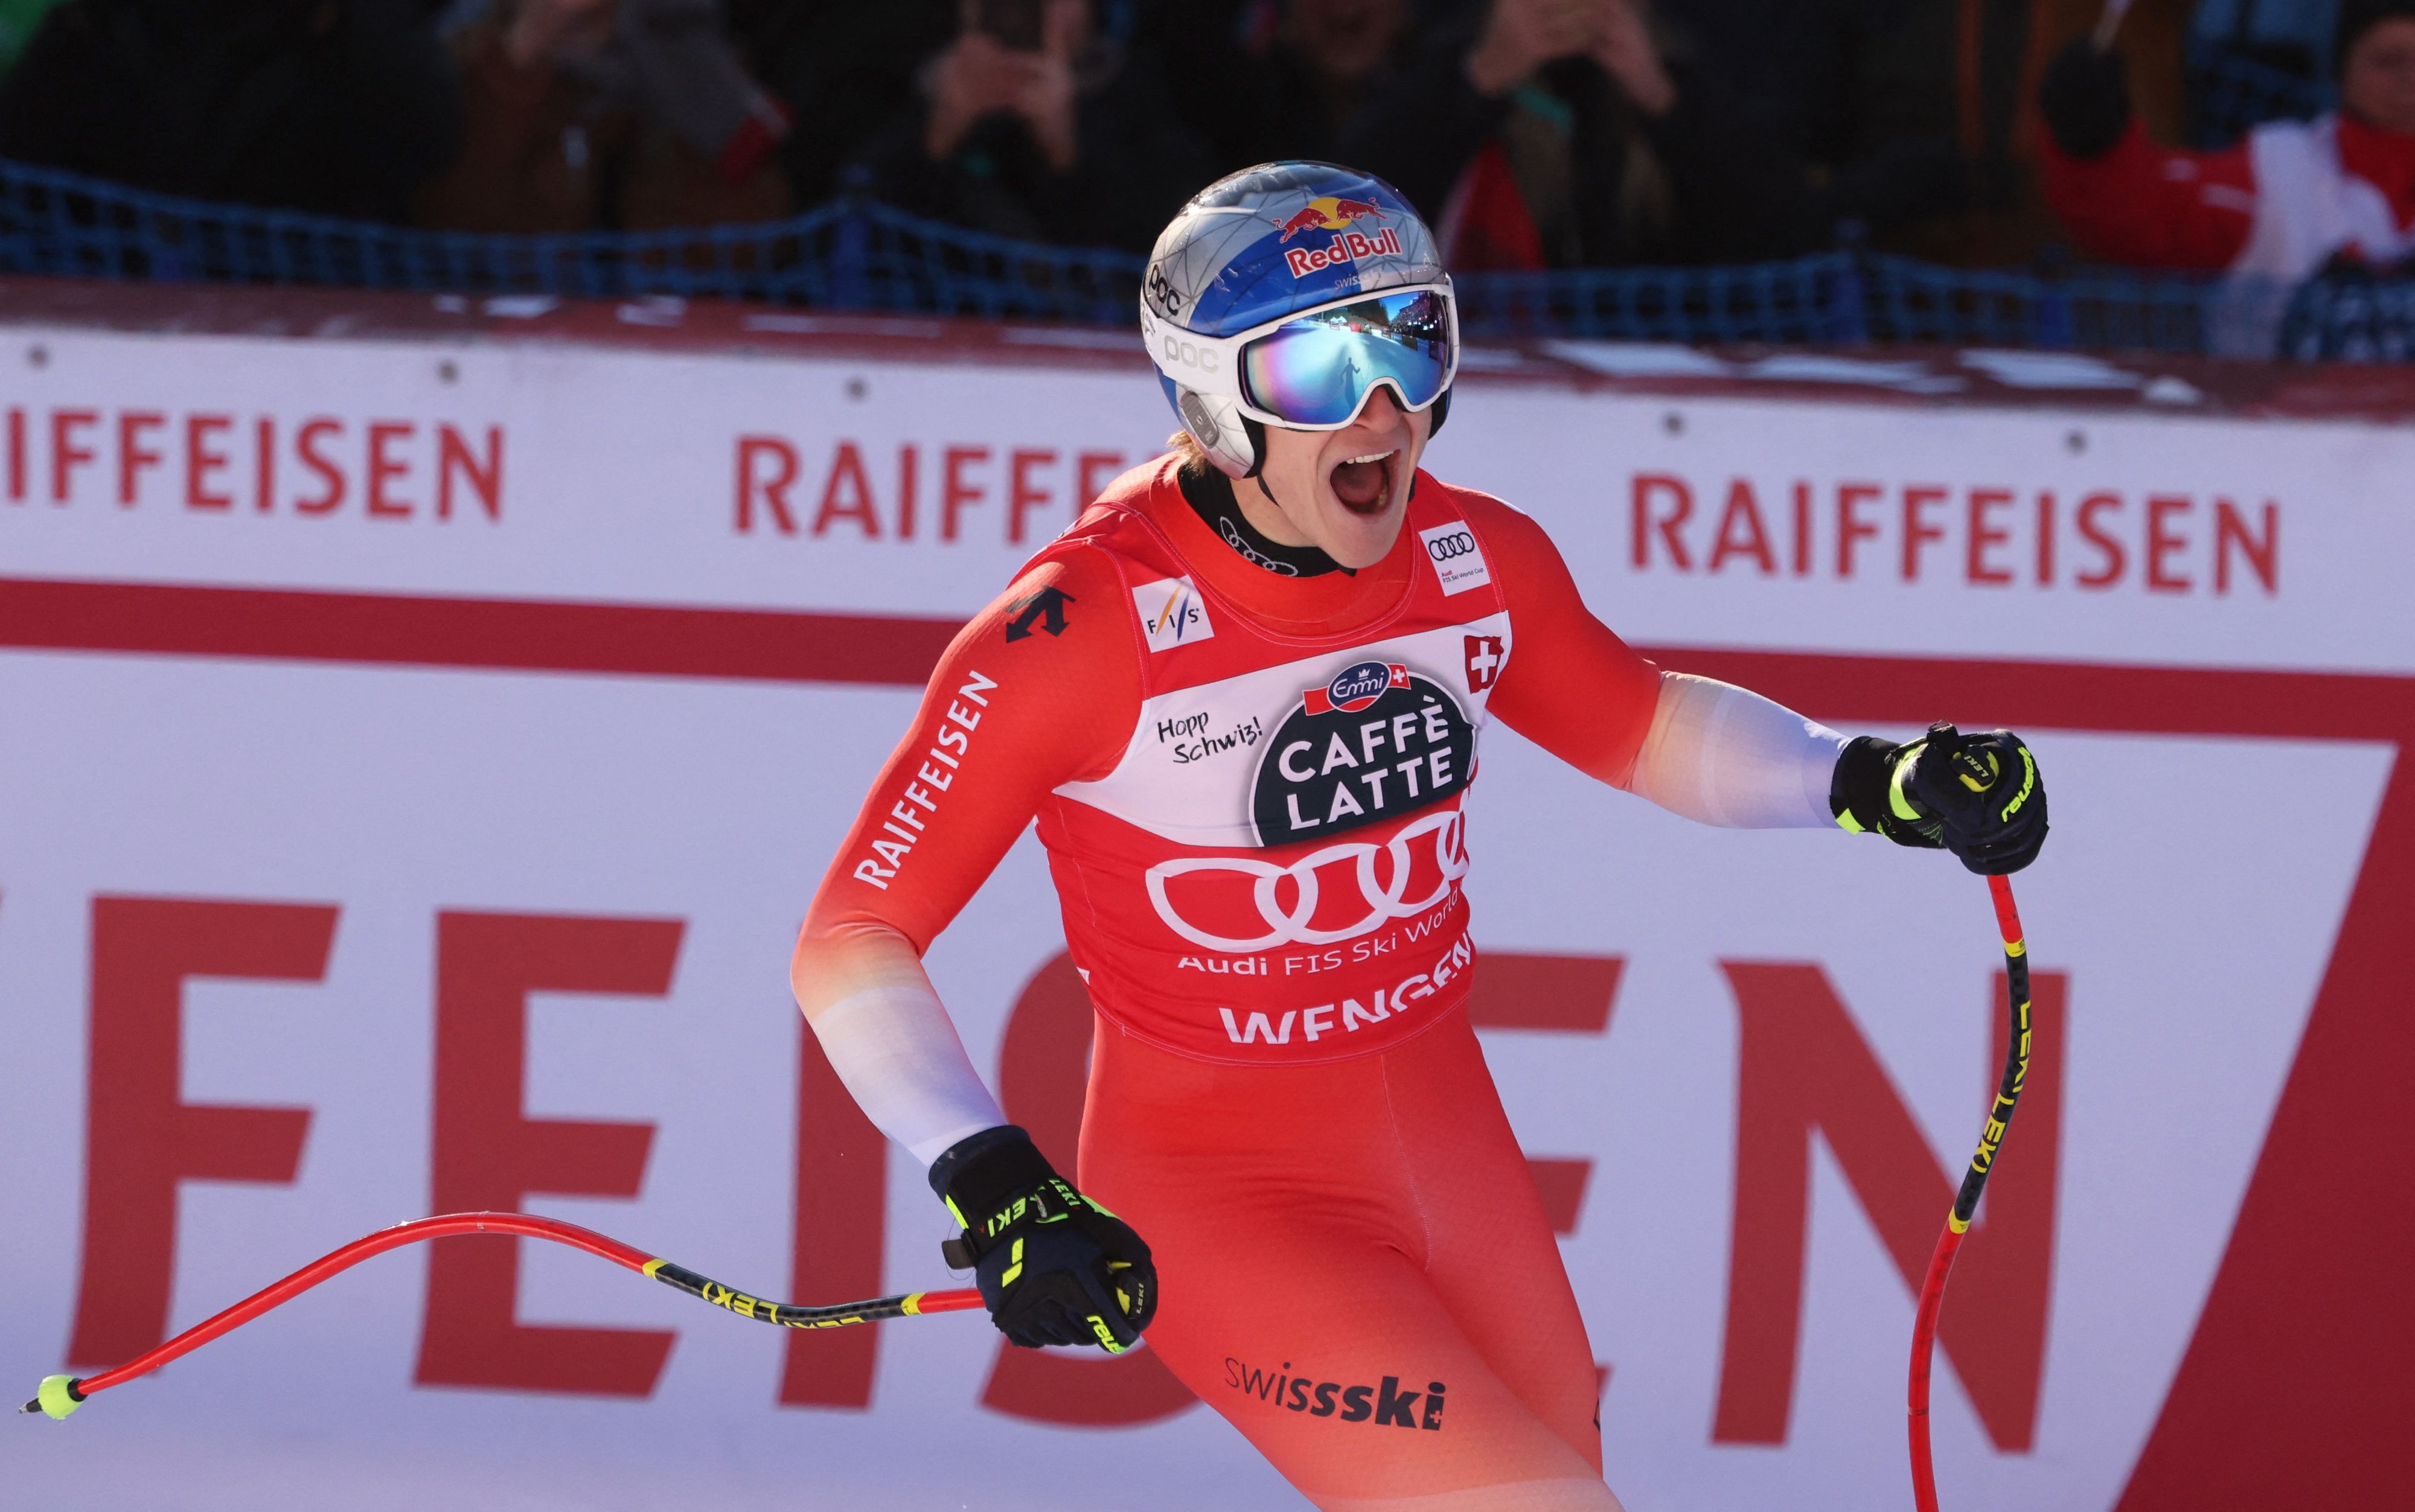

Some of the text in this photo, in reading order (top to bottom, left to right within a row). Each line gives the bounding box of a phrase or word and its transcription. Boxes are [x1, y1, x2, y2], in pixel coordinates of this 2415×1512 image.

[1285, 228, 1401, 278] Red Bull
[7, 407, 504, 522] IFFEISEN
[1630, 473, 2280, 596] RAIFFEISEN
[1332, 672, 1384, 698] Emmi
[1157, 712, 1209, 743] Hopp
[1172, 716, 1262, 764] Schwiz!
[1278, 695, 1448, 783] CAFFÈ
[853, 669, 999, 890] RAIFFEISEN
[1286, 746, 1453, 831] LATTE
[1964, 756, 1989, 777] LEKI
[1178, 887, 1458, 975] Audi FIS Ski World
[1972, 1092, 2014, 1173] LEKI
[1048, 1178, 1081, 1206] LEKI
[702, 1281, 779, 1324] LEKI
[1224, 1357, 1446, 1431] swissski
